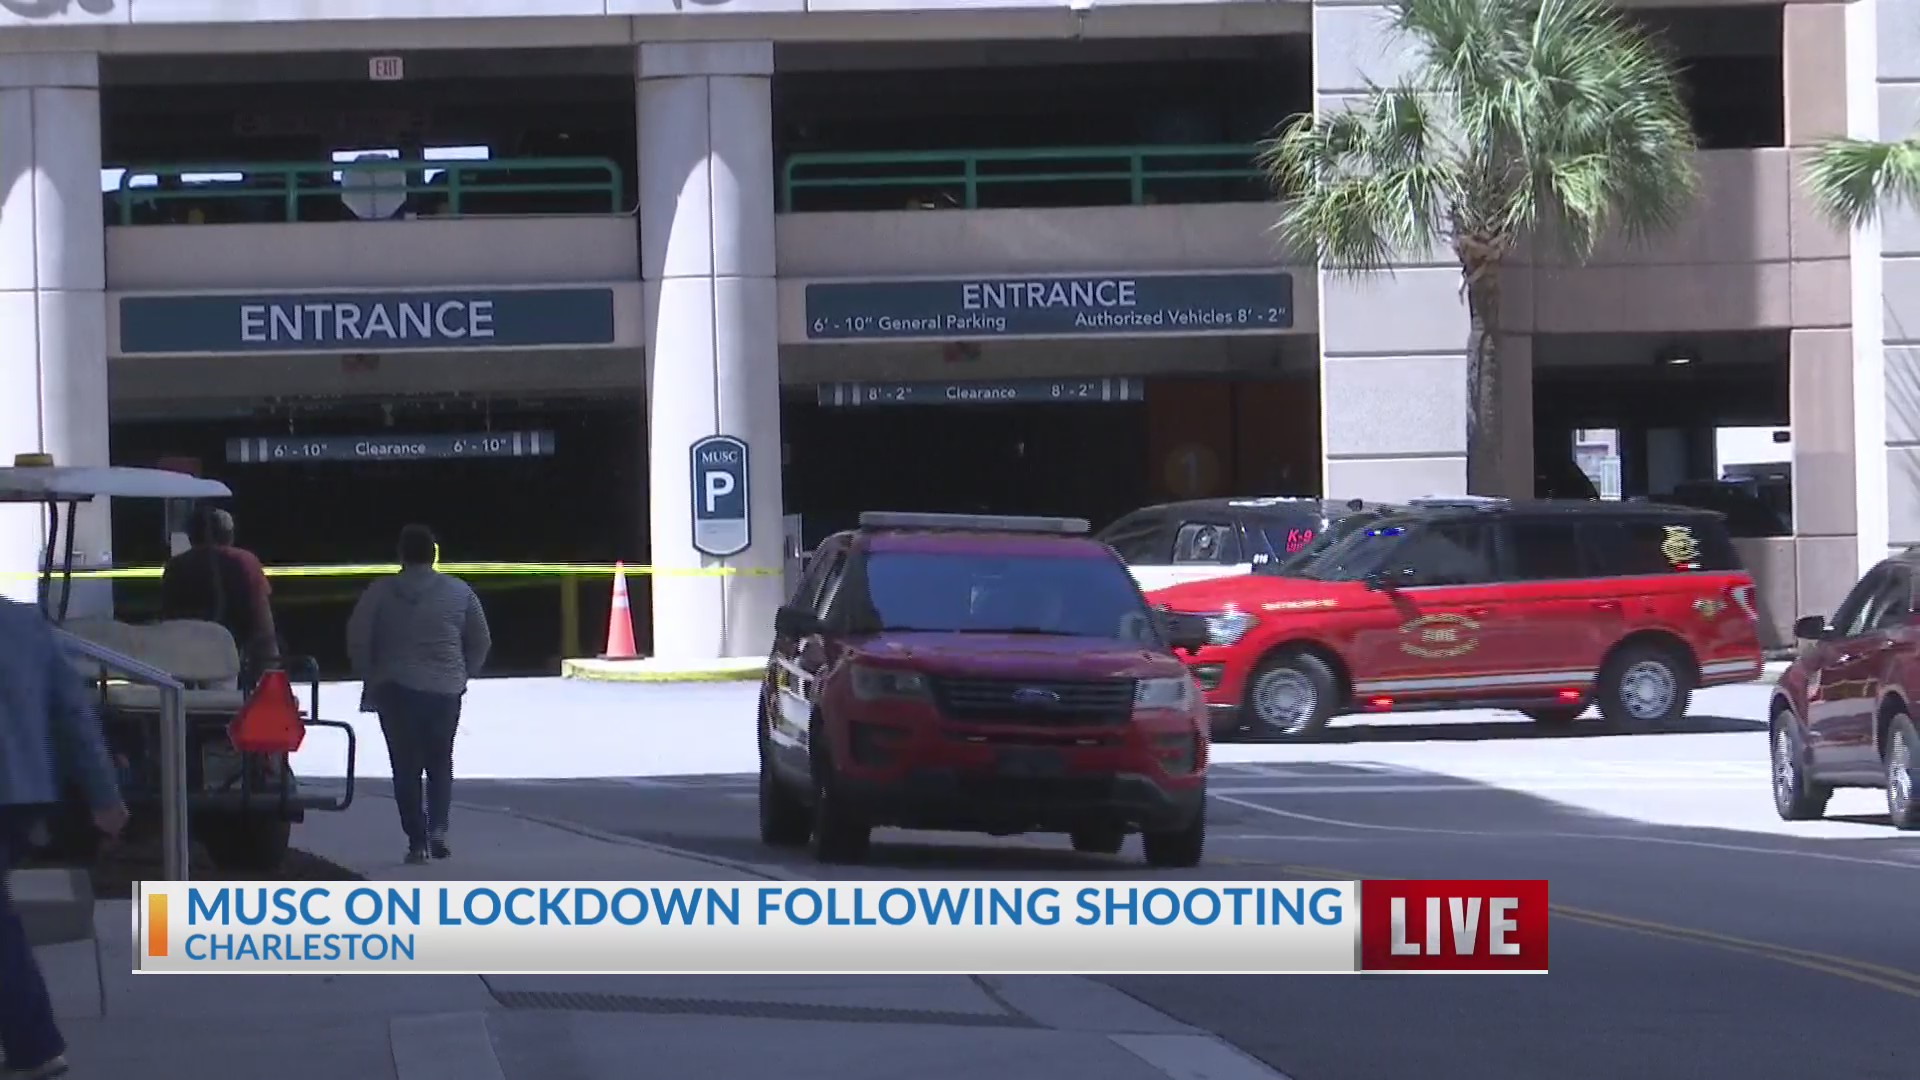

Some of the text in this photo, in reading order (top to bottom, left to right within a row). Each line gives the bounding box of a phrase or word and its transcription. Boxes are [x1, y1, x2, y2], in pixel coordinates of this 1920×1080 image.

[375, 58, 398, 77] EXIT
[962, 280, 1137, 309] ENTRANCE
[240, 300, 495, 341] ENTRANCE
[878, 314, 941, 331] General
[946, 312, 1007, 332] Parking
[1074, 309, 1163, 326] Authorized
[1168, 307, 1233, 325] Vehicles
[945, 386, 1016, 400] Clearance
[354, 441, 427, 456] Clearance
[702, 451, 738, 463] MUSC
[705, 471, 735, 512] P
[1288, 528, 1313, 544] K-9
